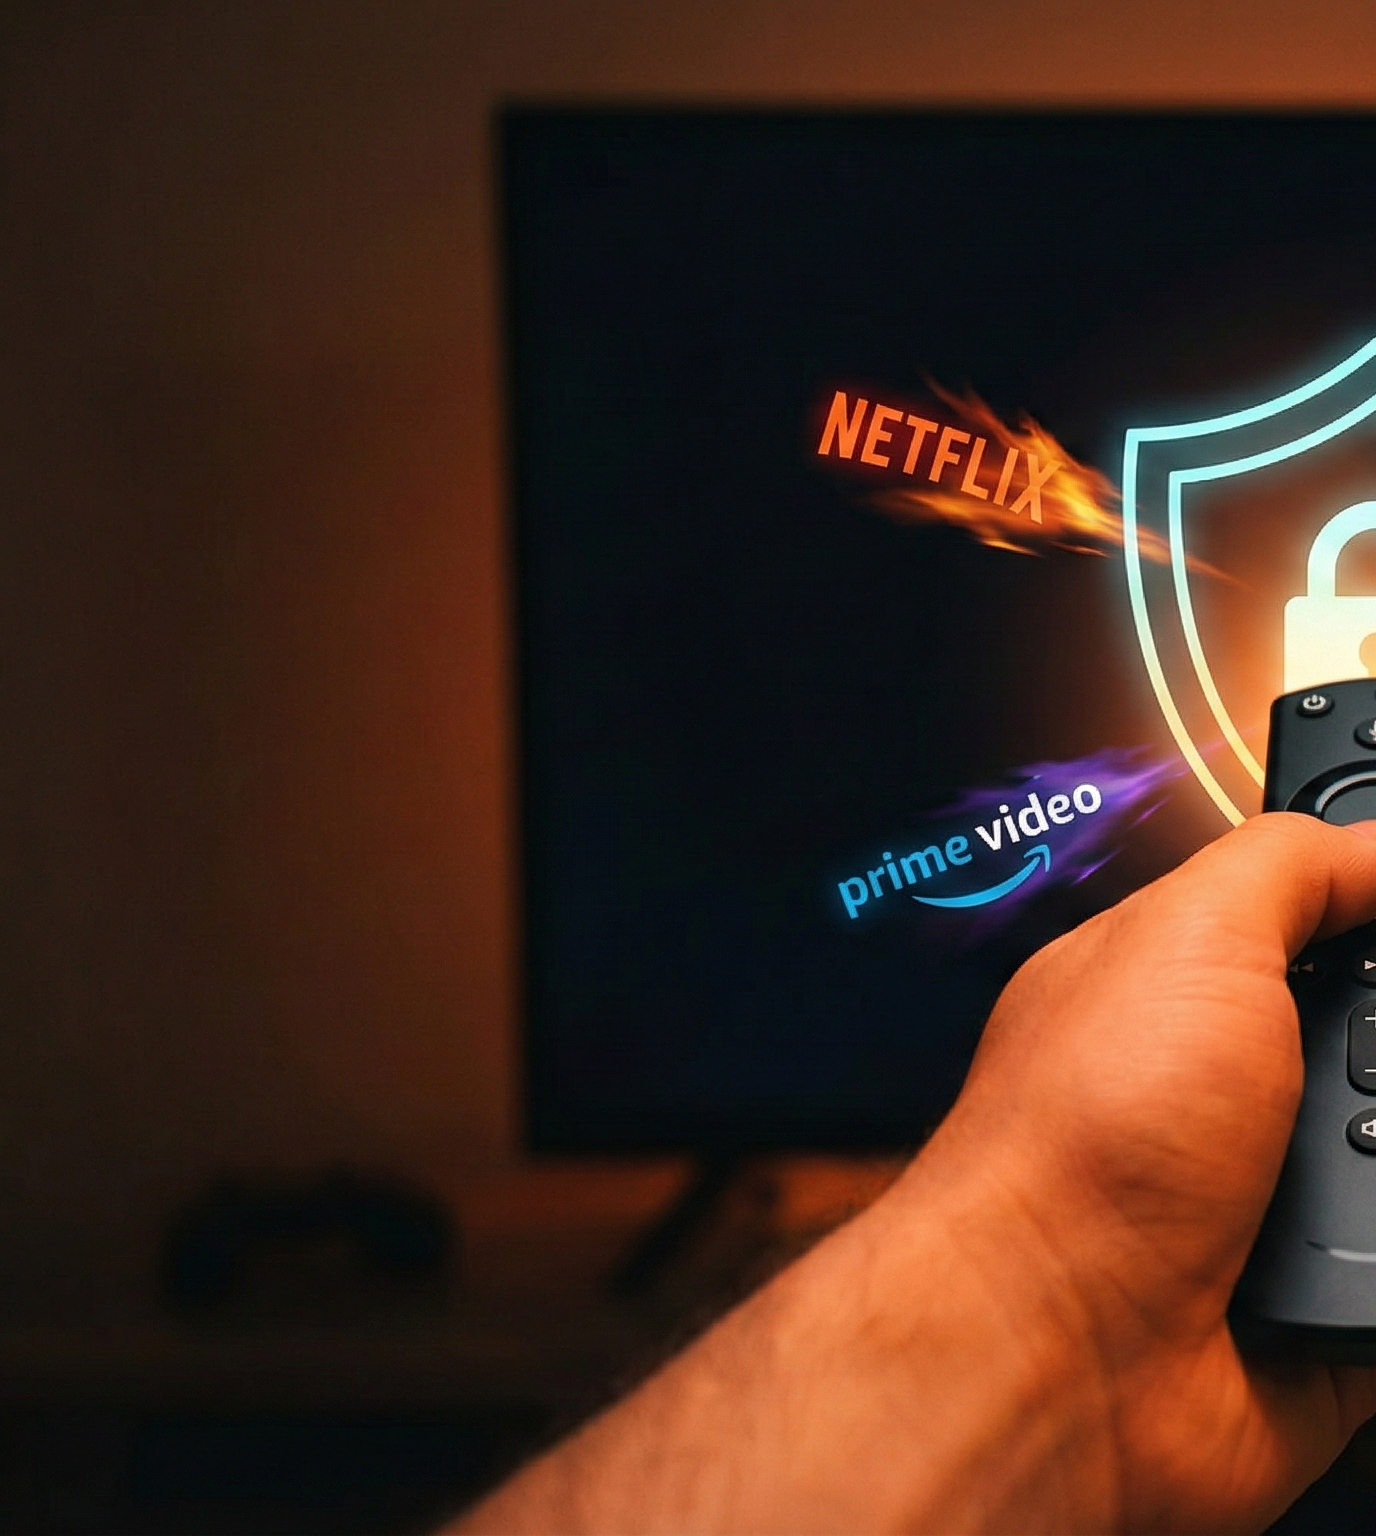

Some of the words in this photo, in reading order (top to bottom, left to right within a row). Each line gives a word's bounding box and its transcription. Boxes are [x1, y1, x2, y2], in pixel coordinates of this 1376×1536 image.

[818, 391, 1061, 524] NETFLIX
[837, 835, 973, 919] prime
[974, 784, 1102, 851] video
